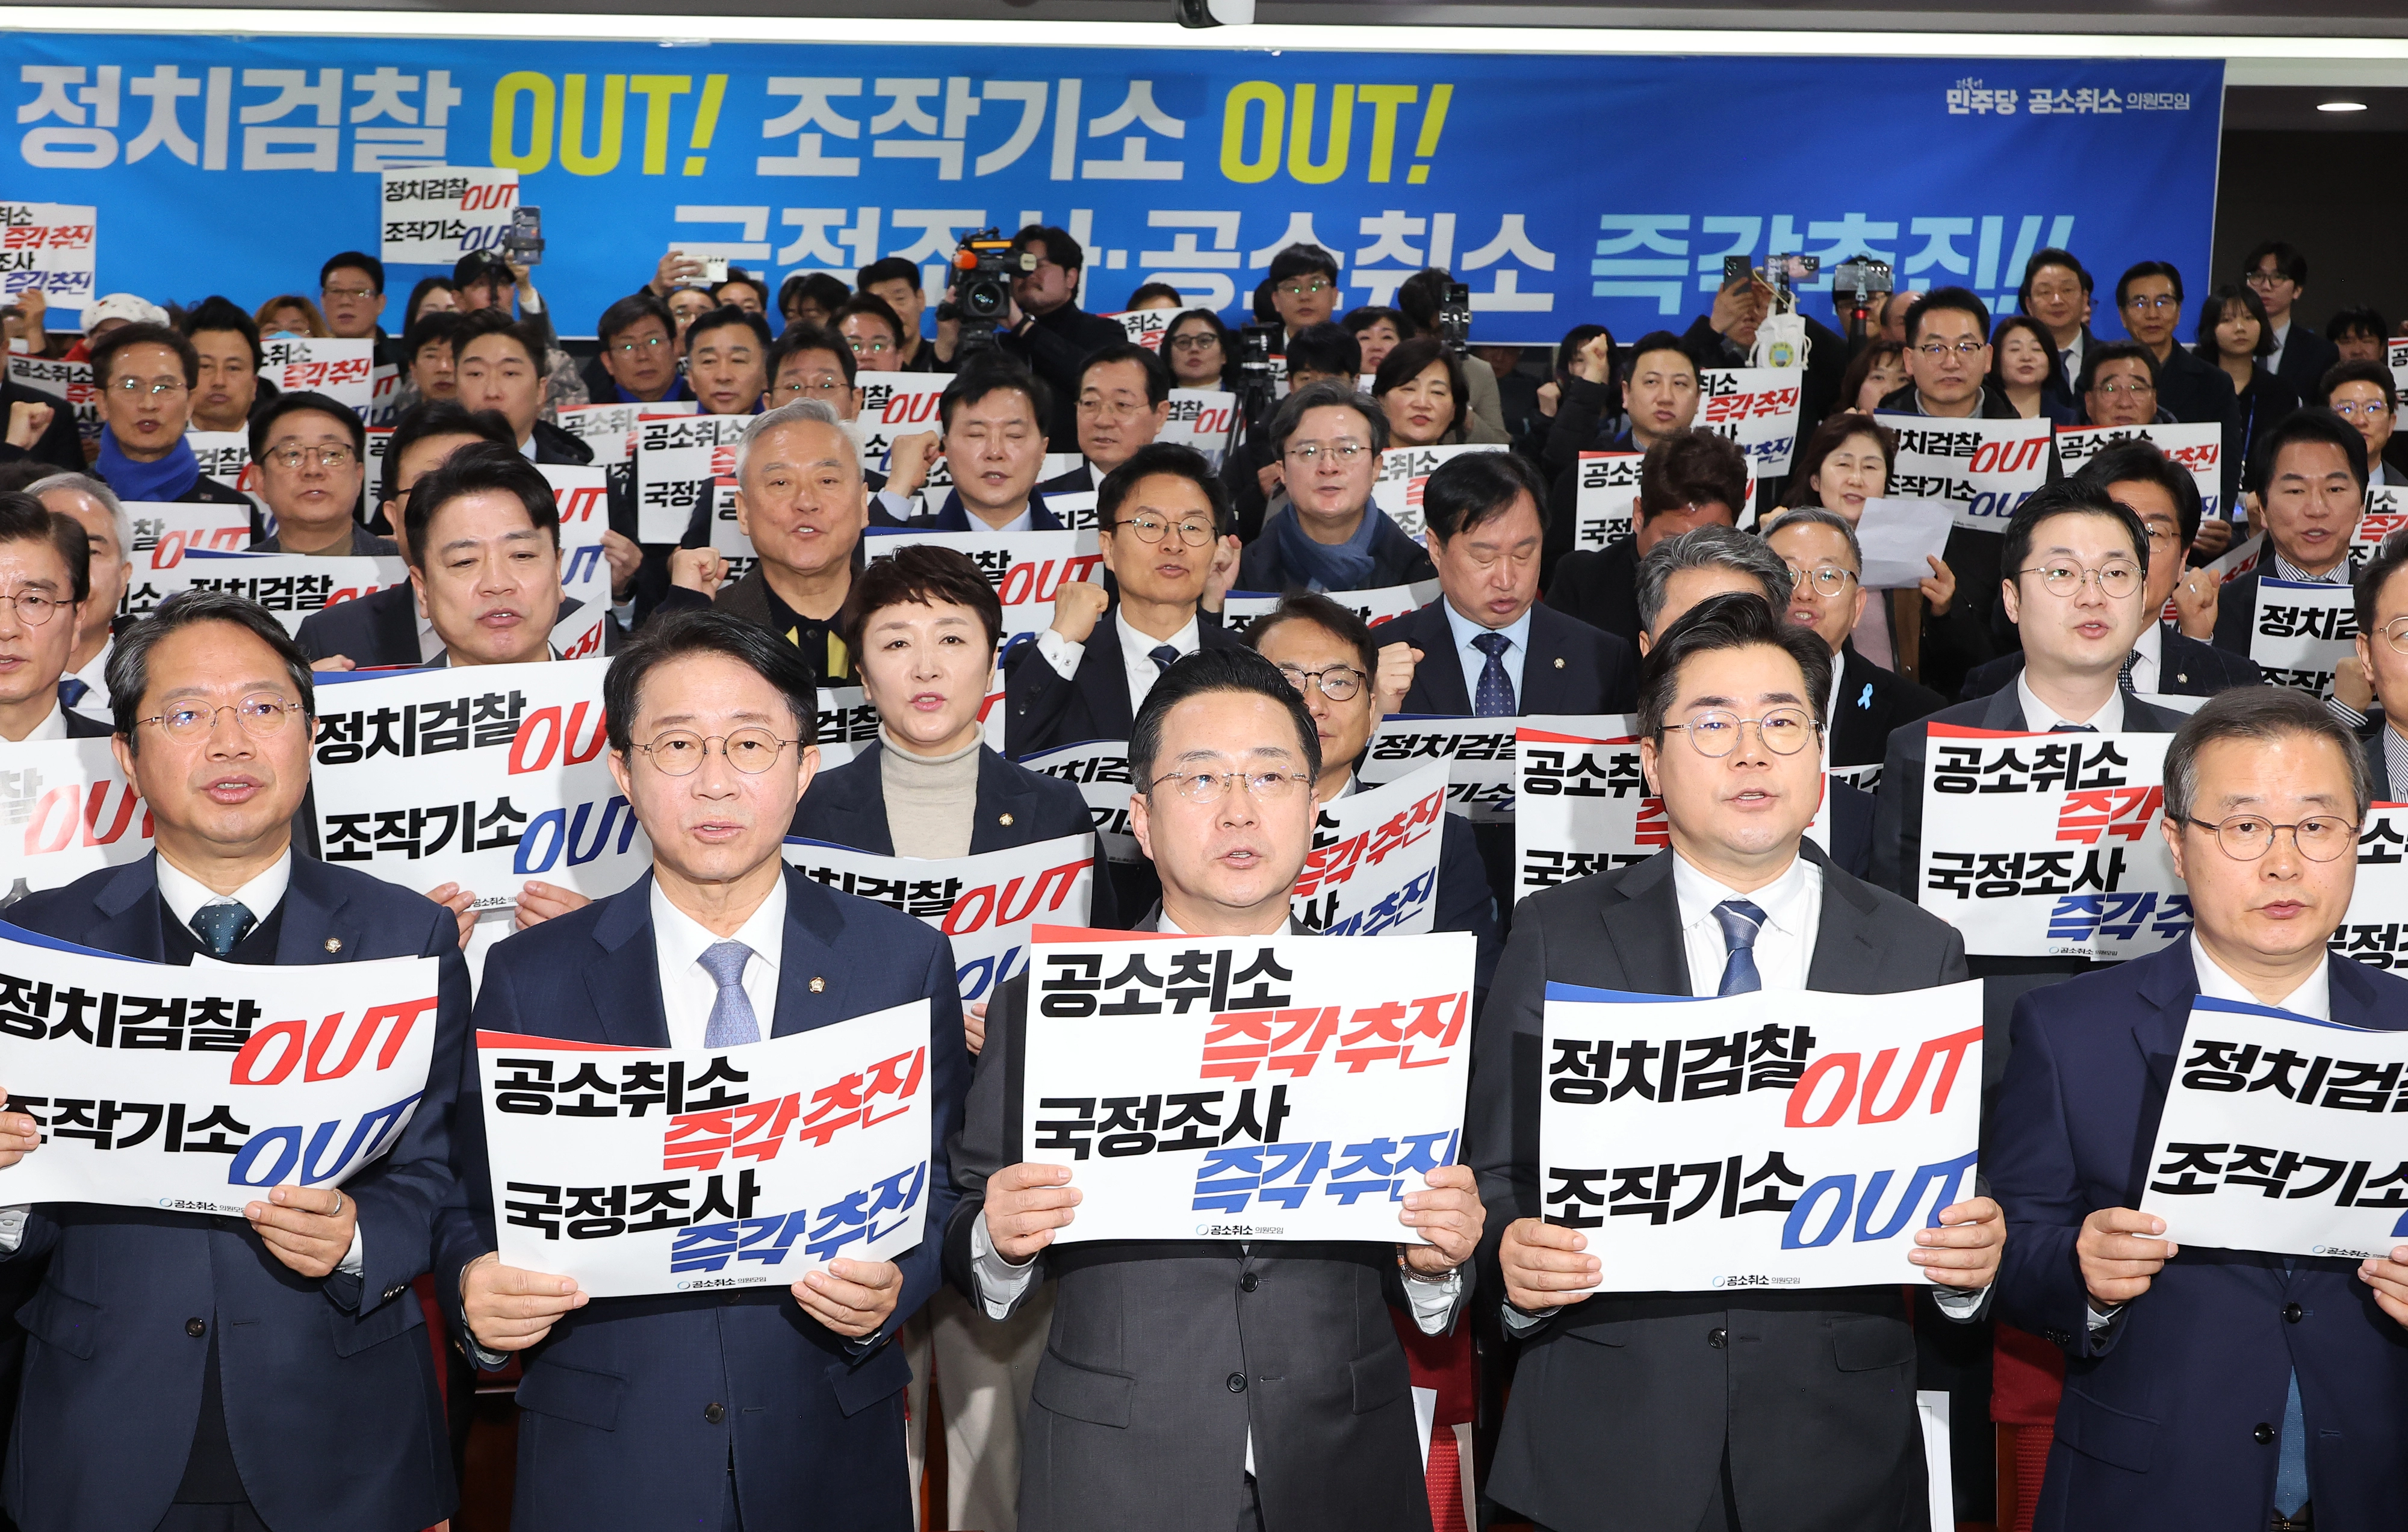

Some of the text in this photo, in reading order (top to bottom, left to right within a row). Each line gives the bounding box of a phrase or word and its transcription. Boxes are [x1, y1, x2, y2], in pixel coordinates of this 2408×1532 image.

[17, 65, 1454, 184] 정치검찰 OUT! 조작기소 OUT!
[1946, 88, 2190, 115] 민주당 공소취소 의원모임
[385, 177, 518, 211] 정치검찰 OUT
[4, 225, 93, 249] 즉각 추진
[385, 219, 512, 250] 조작기소 OU
[48, 271, 92, 295] 추진
[1121, 312, 1163, 332] 취소
[12, 358, 93, 383] 공소취소
[284, 358, 372, 388] 즉각 추진
[1706, 386, 1799, 423] 즉각 추진
[644, 419, 745, 451] 공소취소
[1969, 436, 2051, 473] OUT
[644, 480, 701, 508] 국정
[1969, 491, 2035, 518] OU
[998, 554, 1103, 606] OUT
[315, 690, 607, 775] 정치검찰 OU
[1934, 741, 2128, 794] 공소취소
[25, 779, 155, 857] OU
[326, 796, 527, 862] 조작기소
[1365, 785, 1445, 867] 추진
[2055, 786, 2164, 845] 즉각
[941, 857, 1094, 936] OUT
[1928, 846, 2126, 899] 국정조사
[2047, 892, 2159, 942] 즉각
[1040, 947, 1293, 1018] 공소취소
[0, 973, 439, 1086] 정치검찰 OUT
[1199, 990, 1469, 1083] 즉각 추진
[494, 1055, 749, 1117] 공소취소
[1548, 1023, 1984, 1128] 정치검찰 OUT
[2181, 1040, 2408, 1113] 정치검
[663, 1045, 925, 1171] 즉각 추진
[1034, 1084, 1291, 1161] 국정조사
[228, 1088, 426, 1187] OUT
[1191, 1127, 1460, 1215] 즉각 추진
[174, 1199, 218, 1211] 공소취소
[505, 1168, 761, 1241] 국정조사
[670, 1159, 927, 1274] 즉각 추진
[1544, 1149, 1979, 1250] 조작기소 OUT
[1211, 1225, 1253, 1235] 공소취소
[2327, 1247, 2371, 1258] 공소취소
[692, 1277, 736, 1289] 공소취소
[1727, 1274, 1770, 1286] 공소취소
